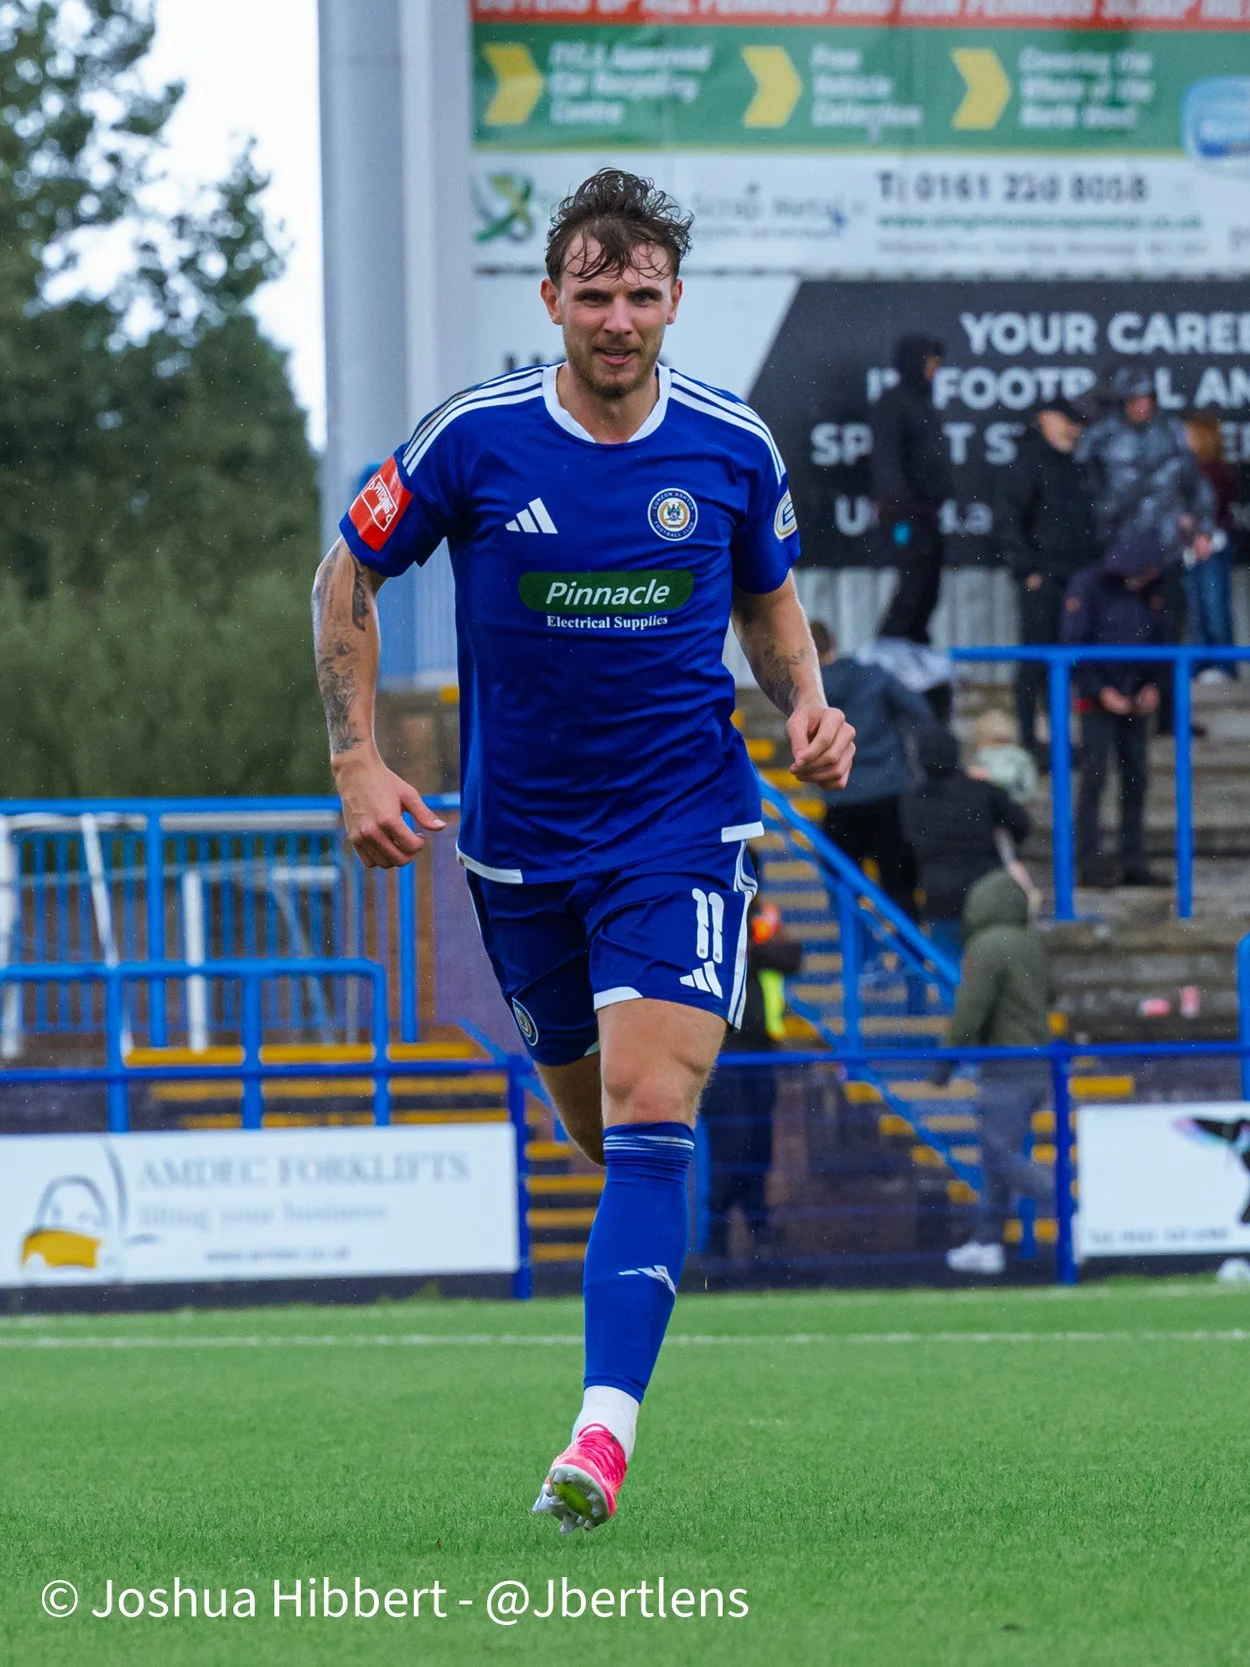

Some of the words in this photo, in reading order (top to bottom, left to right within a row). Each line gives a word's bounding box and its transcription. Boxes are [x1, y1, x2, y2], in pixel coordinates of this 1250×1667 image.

[914, 171, 990, 201] 0161
[960, 311, 1098, 355] YOUR
[545, 578, 671, 606] Pinnacle
[546, 615, 610, 629] Electrical
[613, 614, 669, 630] Supplies
[691, 888, 724, 963] 11
[137, 1156, 266, 1189] AMDEC
[278, 1151, 470, 1186] FORKLIFTS
[138, 1202, 206, 1228] lifting
[221, 1205, 274, 1228] your
[284, 1199, 387, 1222] business
